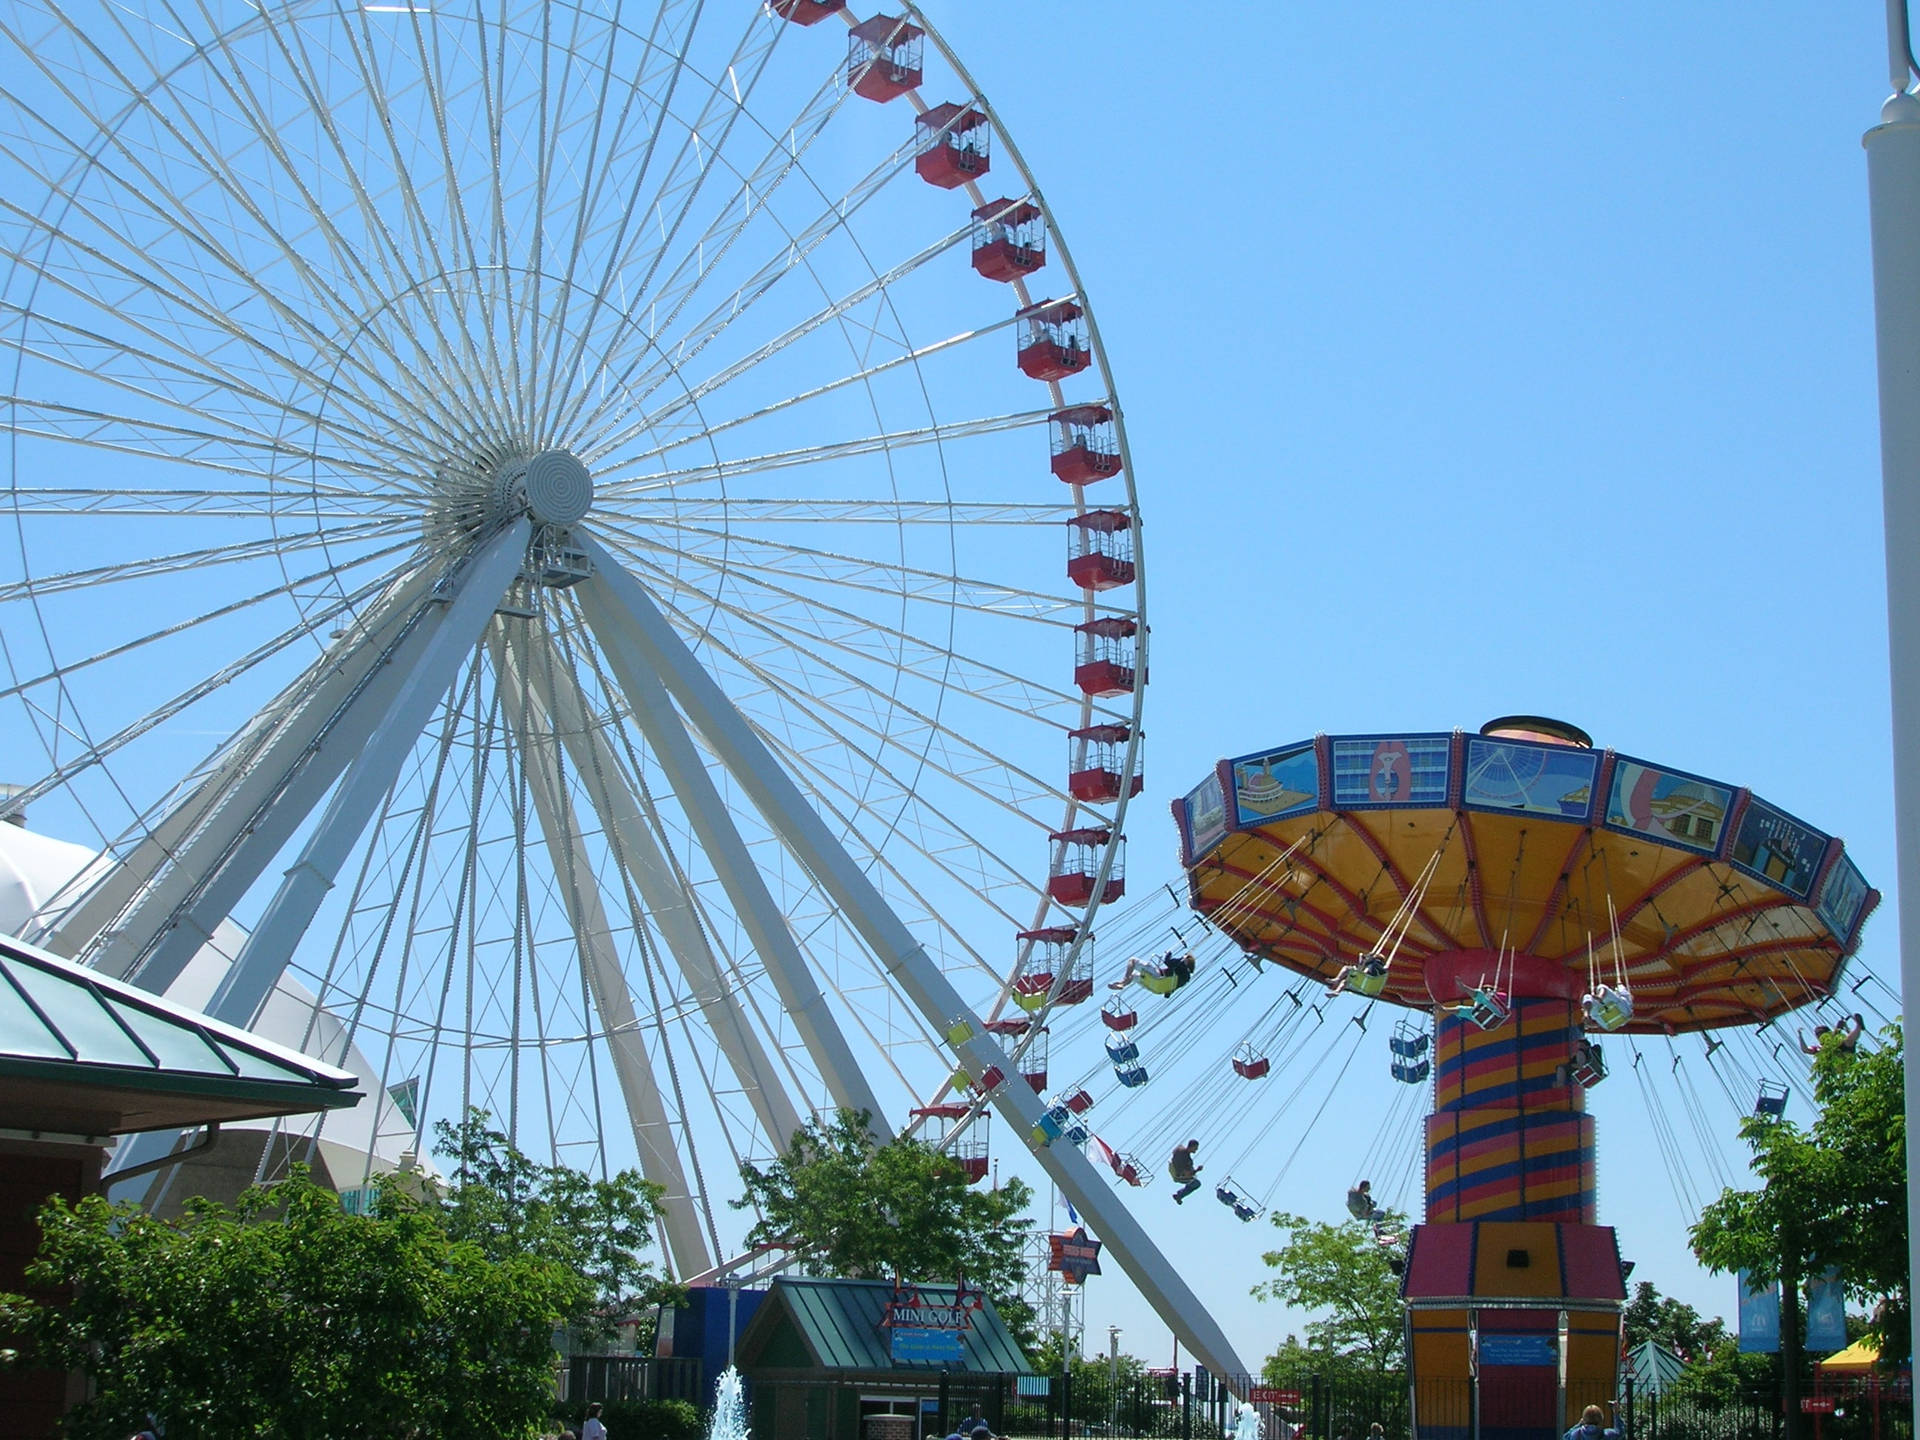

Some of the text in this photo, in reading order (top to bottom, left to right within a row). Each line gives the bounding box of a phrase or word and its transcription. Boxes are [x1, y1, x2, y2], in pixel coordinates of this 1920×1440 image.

[893, 1308, 961, 1324] MINI GOLF
[1253, 1390, 1278, 1400] EXIT
